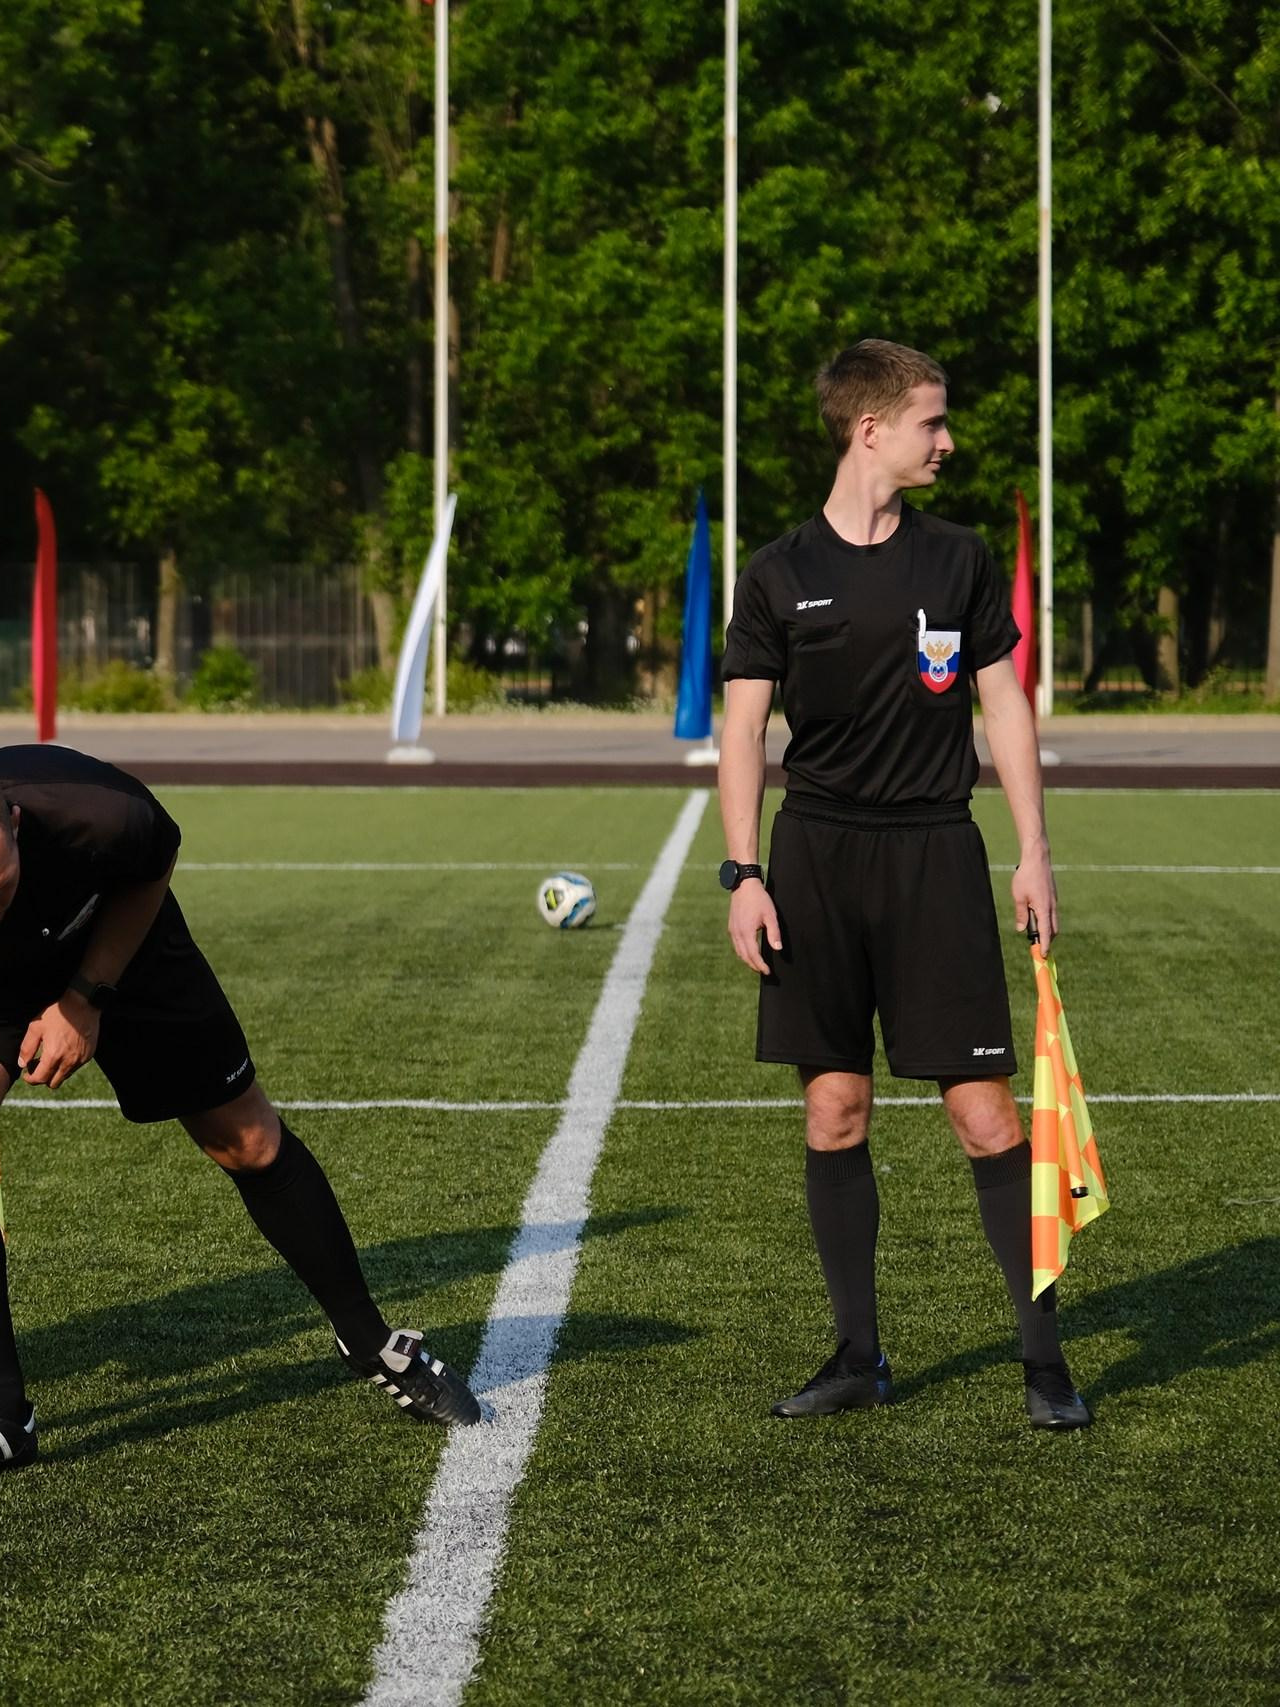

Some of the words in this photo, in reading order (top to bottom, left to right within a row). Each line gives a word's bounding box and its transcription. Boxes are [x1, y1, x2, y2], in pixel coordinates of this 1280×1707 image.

[796, 600, 809, 610] 2K
[808, 598, 833, 608] SPORT
[972, 1047, 986, 1056] 2K
[985, 1047, 1006, 1055] SPORT
